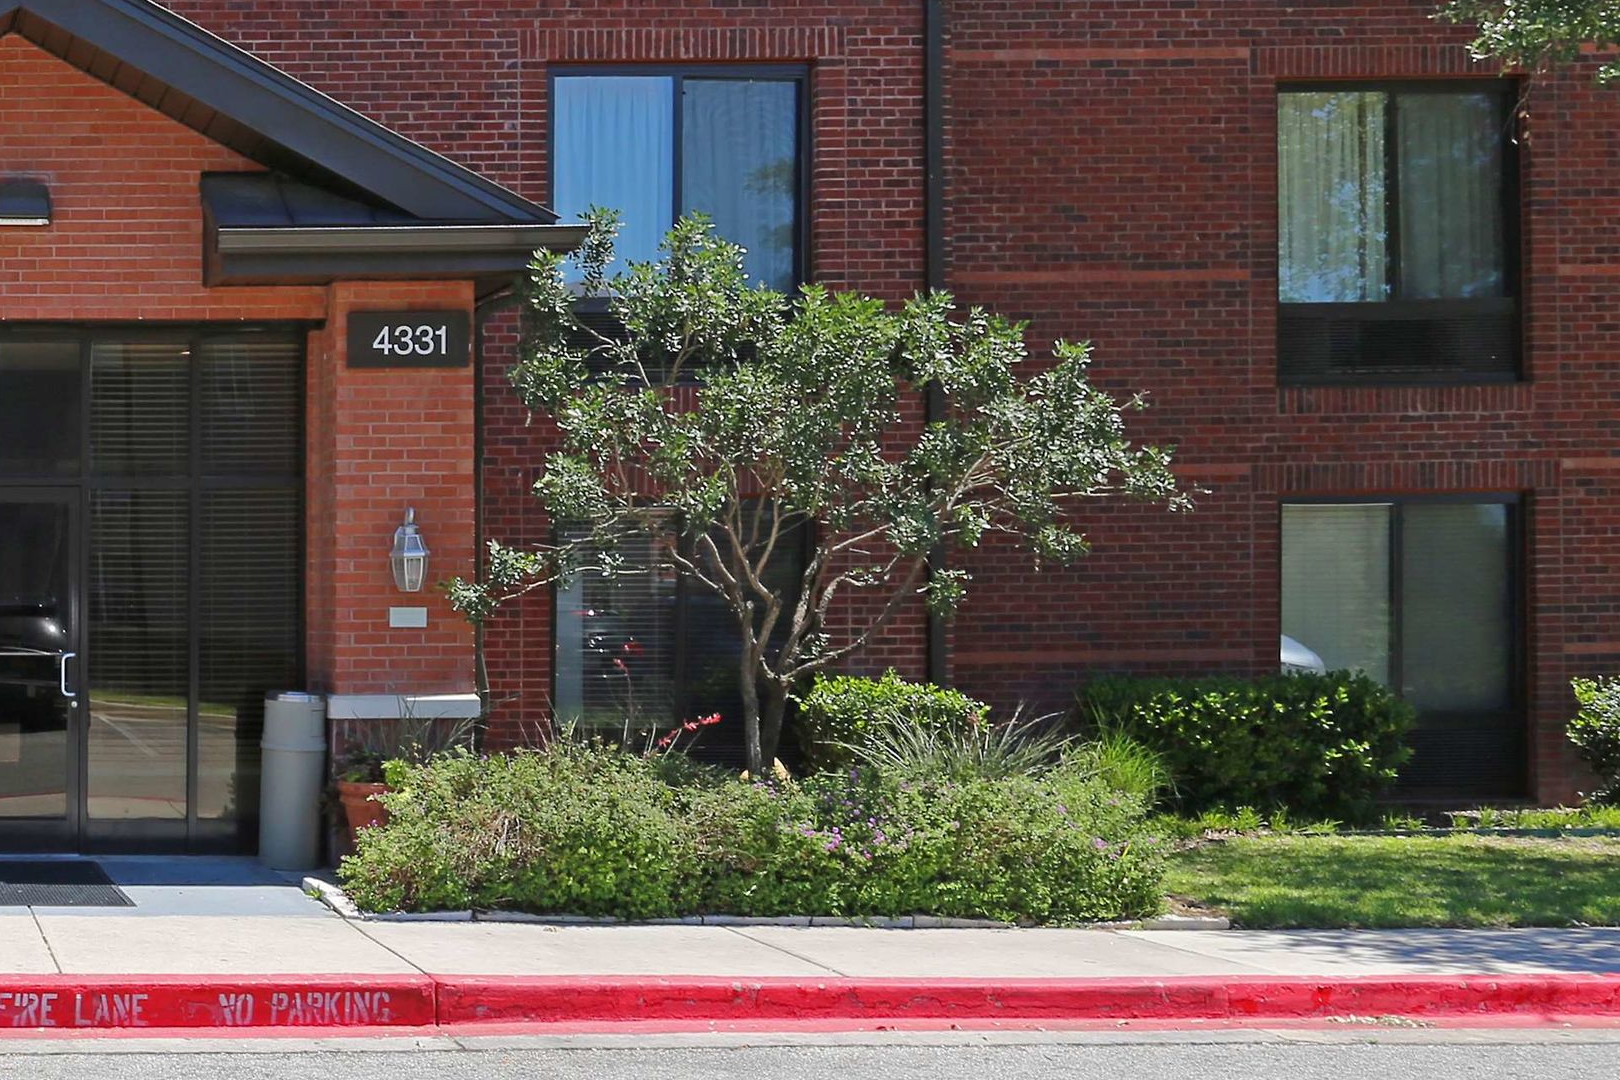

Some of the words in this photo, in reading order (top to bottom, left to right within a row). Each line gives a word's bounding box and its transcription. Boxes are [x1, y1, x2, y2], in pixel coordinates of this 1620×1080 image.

[372, 325, 447, 355] 4331
[74, 993, 149, 1026] LANE
[218, 993, 255, 1026] NO
[270, 991, 391, 1025] PARKING
